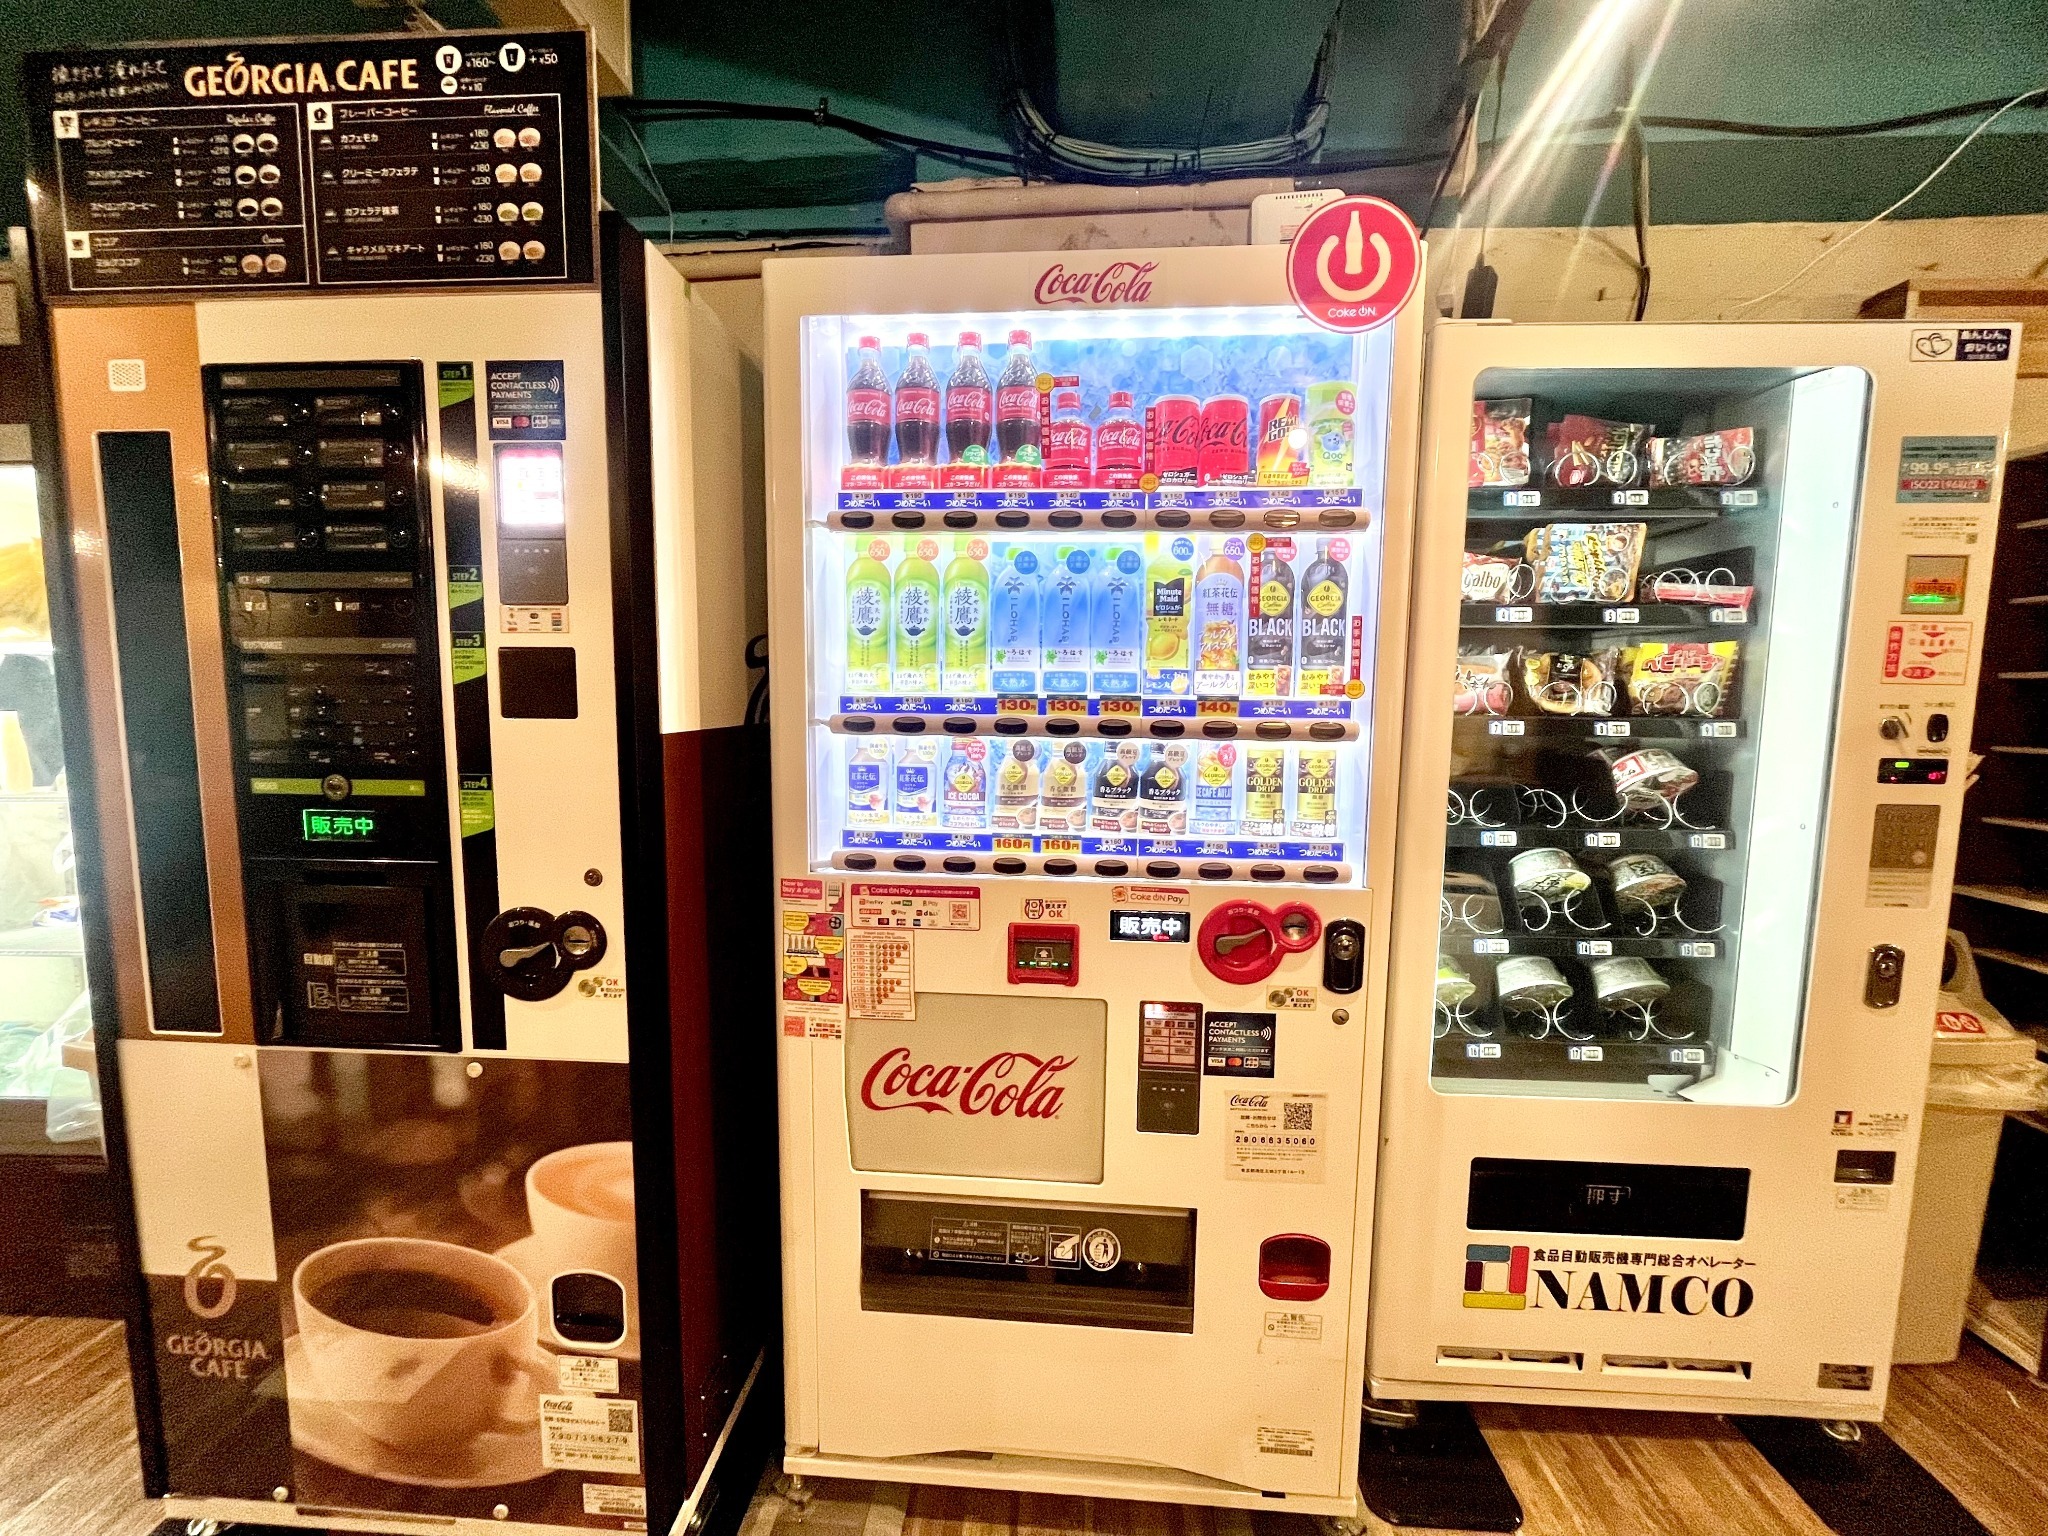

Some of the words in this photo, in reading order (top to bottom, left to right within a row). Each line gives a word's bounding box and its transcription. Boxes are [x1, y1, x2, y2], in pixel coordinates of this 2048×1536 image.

[184, 51, 330, 98] GEORGIA
[335, 58, 419, 92] CAFE
[340, 107, 418, 119] フレーバーコーヒー
[340, 134, 378, 144] カフェモカ
[342, 167, 419, 178] クリーミーカフェラテ
[1034, 260, 1159, 305] Coca-Cola
[1327, 306, 1357, 318] Coke
[1358, 304, 1377, 317] ON
[491, 372, 521, 380] ACCEPT
[490, 381, 547, 390] CONTACTLESS
[490, 390, 532, 399] PAYMENTS
[946, 389, 988, 411] Coca-Cola
[997, 388, 1040, 410] Coca-Cola
[896, 397, 936, 417] Coca-Cola
[1098, 426, 1142, 449] Coca-Cola
[1322, 451, 1344, 461] Qoo
[452, 567, 478, 581] STEP2
[1464, 570, 1501, 589] galbo
[1156, 587, 1182, 597] Minute
[1202, 587, 1239, 599] 紅茶花伝
[1160, 594, 1179, 604] Maid
[1310, 594, 1342, 603] GEORGIA
[856, 586, 875, 626] 綾鷹
[905, 586, 924, 626] 綾鷹
[954, 586, 973, 626] 綾鷹
[1155, 603, 1183, 612] ゼロシュガー
[1248, 618, 1293, 637] BLACK
[1302, 618, 1346, 638] BLACK
[455, 633, 481, 647] STEP3
[1003, 649, 1033, 657] いろはす
[1054, 649, 1083, 657] いろはす
[999, 676, 1029, 689] 天然水
[1050, 677, 1080, 689] 天然水
[1100, 677, 1130, 690] 天然水
[998, 699, 1037, 712] 130円
[1047, 700, 1086, 712] 130円
[1100, 700, 1139, 713] 130円
[1198, 700, 1237, 713] 140円
[463, 776, 488, 789] STEP4
[899, 773, 925, 784] 紅茶花伝
[1246, 776, 1283, 787] GOLDEN
[1298, 778, 1335, 788] GOLDEN
[1099, 785, 1132, 794] 香るブラック
[1148, 788, 1182, 796] 香るブラック
[1307, 787, 1328, 795] DRIP
[947, 791, 957, 800] ICE
[958, 792, 980, 801] COCOA
[311, 815, 374, 836] 販売中
[994, 838, 1031, 850] 160円
[1043, 839, 1080, 851] 160円
[1485, 835, 1493, 843] 10
[1588, 836, 1595, 845] 11
[901, 888, 914, 896] Pay
[1130, 892, 1152, 901] Coke
[1167, 894, 1184, 904] Pay
[1048, 909, 1063, 918] OK
[1118, 916, 1182, 935] 販売中
[1581, 944, 1588, 954] 14
[605, 978, 619, 987] OK
[1296, 989, 1309, 997] OK
[1208, 1028, 1260, 1037] CONTACTLESS
[1208, 1036, 1247, 1044] PAYMENTS
[1572, 1049, 1579, 1058] 17
[860, 1047, 1079, 1119] Coca-Cola
[1230, 1094, 1271, 1108] Coca-Cola
[1532, 1248, 1757, 1269] 食品自動販売機専門総合オペレーター
[1529, 1269, 1755, 1318] NAMCO
[166, 1330, 268, 1360] GEORGIA
[188, 1355, 248, 1380] CAFE
